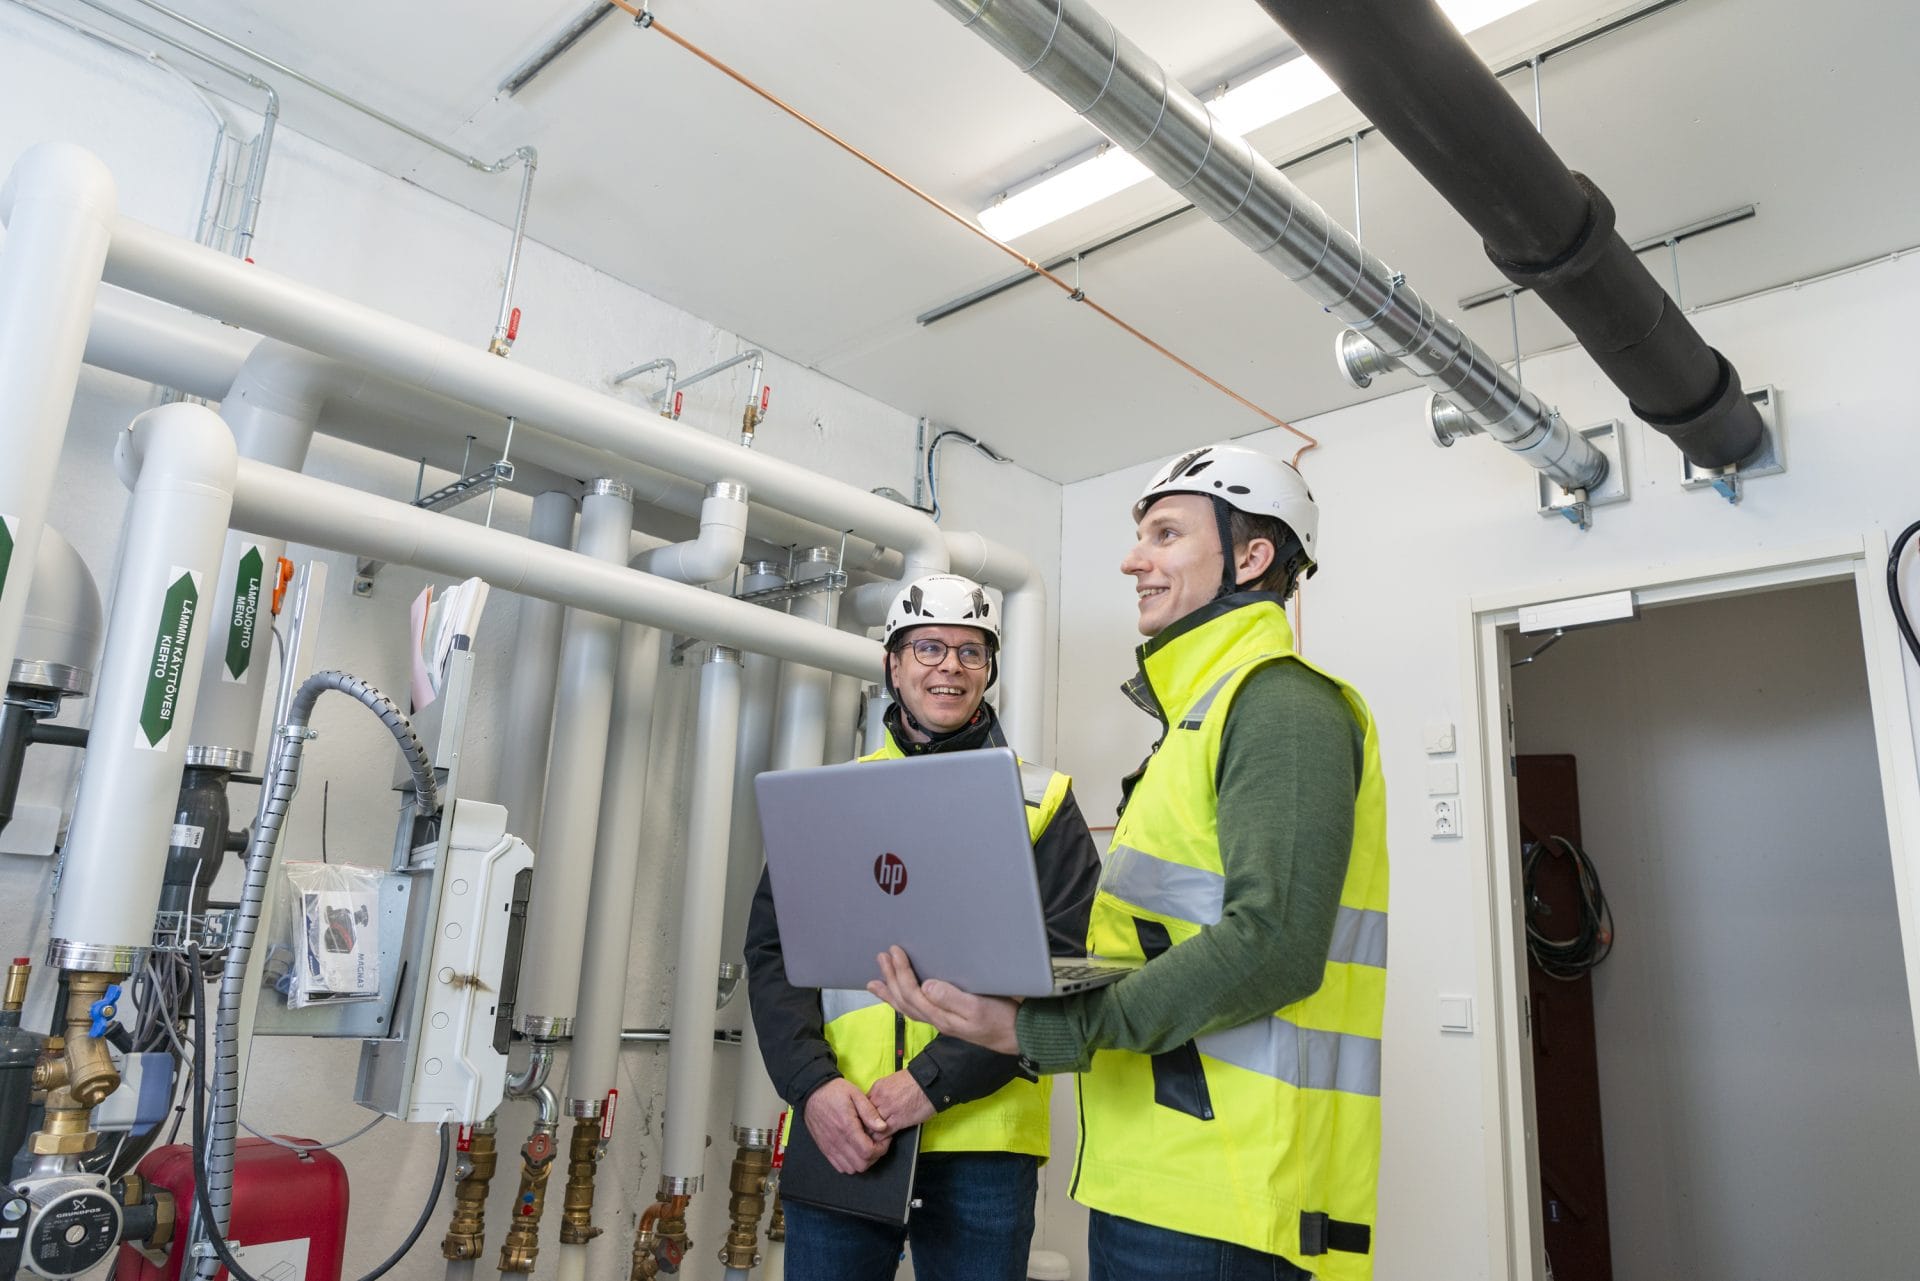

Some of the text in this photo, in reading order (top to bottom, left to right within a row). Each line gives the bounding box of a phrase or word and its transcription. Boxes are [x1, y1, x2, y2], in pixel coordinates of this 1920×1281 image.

[234, 595, 246, 627] MENO
[241, 577, 259, 649] LÄMPÖJOHTO
[154, 635, 172, 678] KIERTO
[159, 599, 193, 720] LÄMMIN KÄYTTÖVESI
[357, 953, 365, 989] MAGNA3
[56, 1207, 102, 1218] GRUNDFOS
